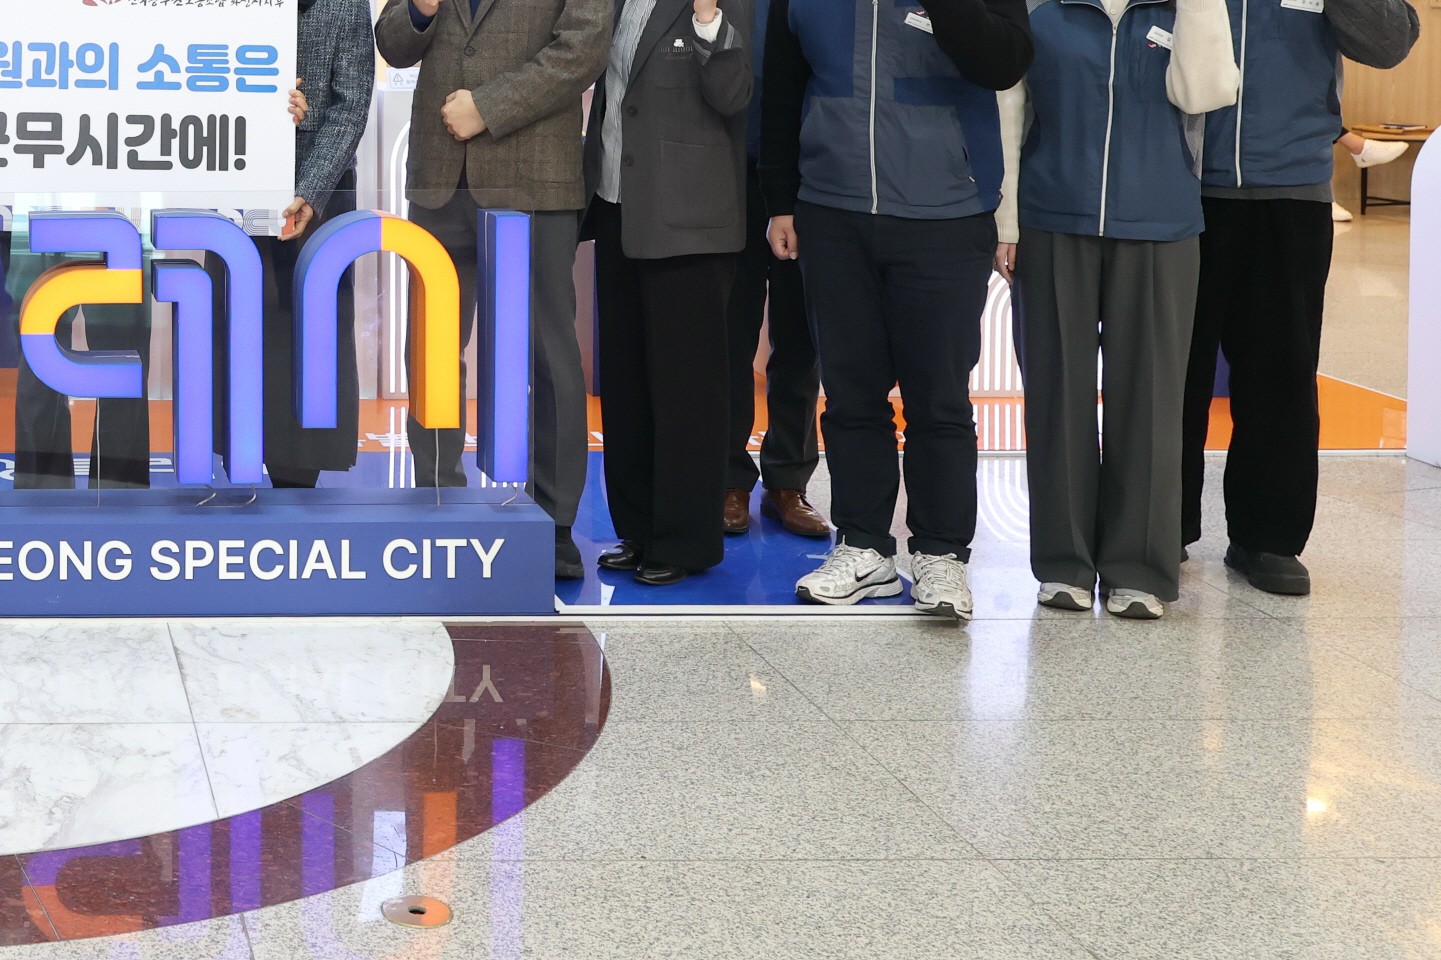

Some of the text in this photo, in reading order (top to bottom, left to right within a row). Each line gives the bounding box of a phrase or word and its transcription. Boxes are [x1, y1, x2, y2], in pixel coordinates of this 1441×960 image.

[135, 43, 280, 94] 소통은
[150, 539, 366, 581] SPECIAL
[382, 538, 505, 580] CITY
